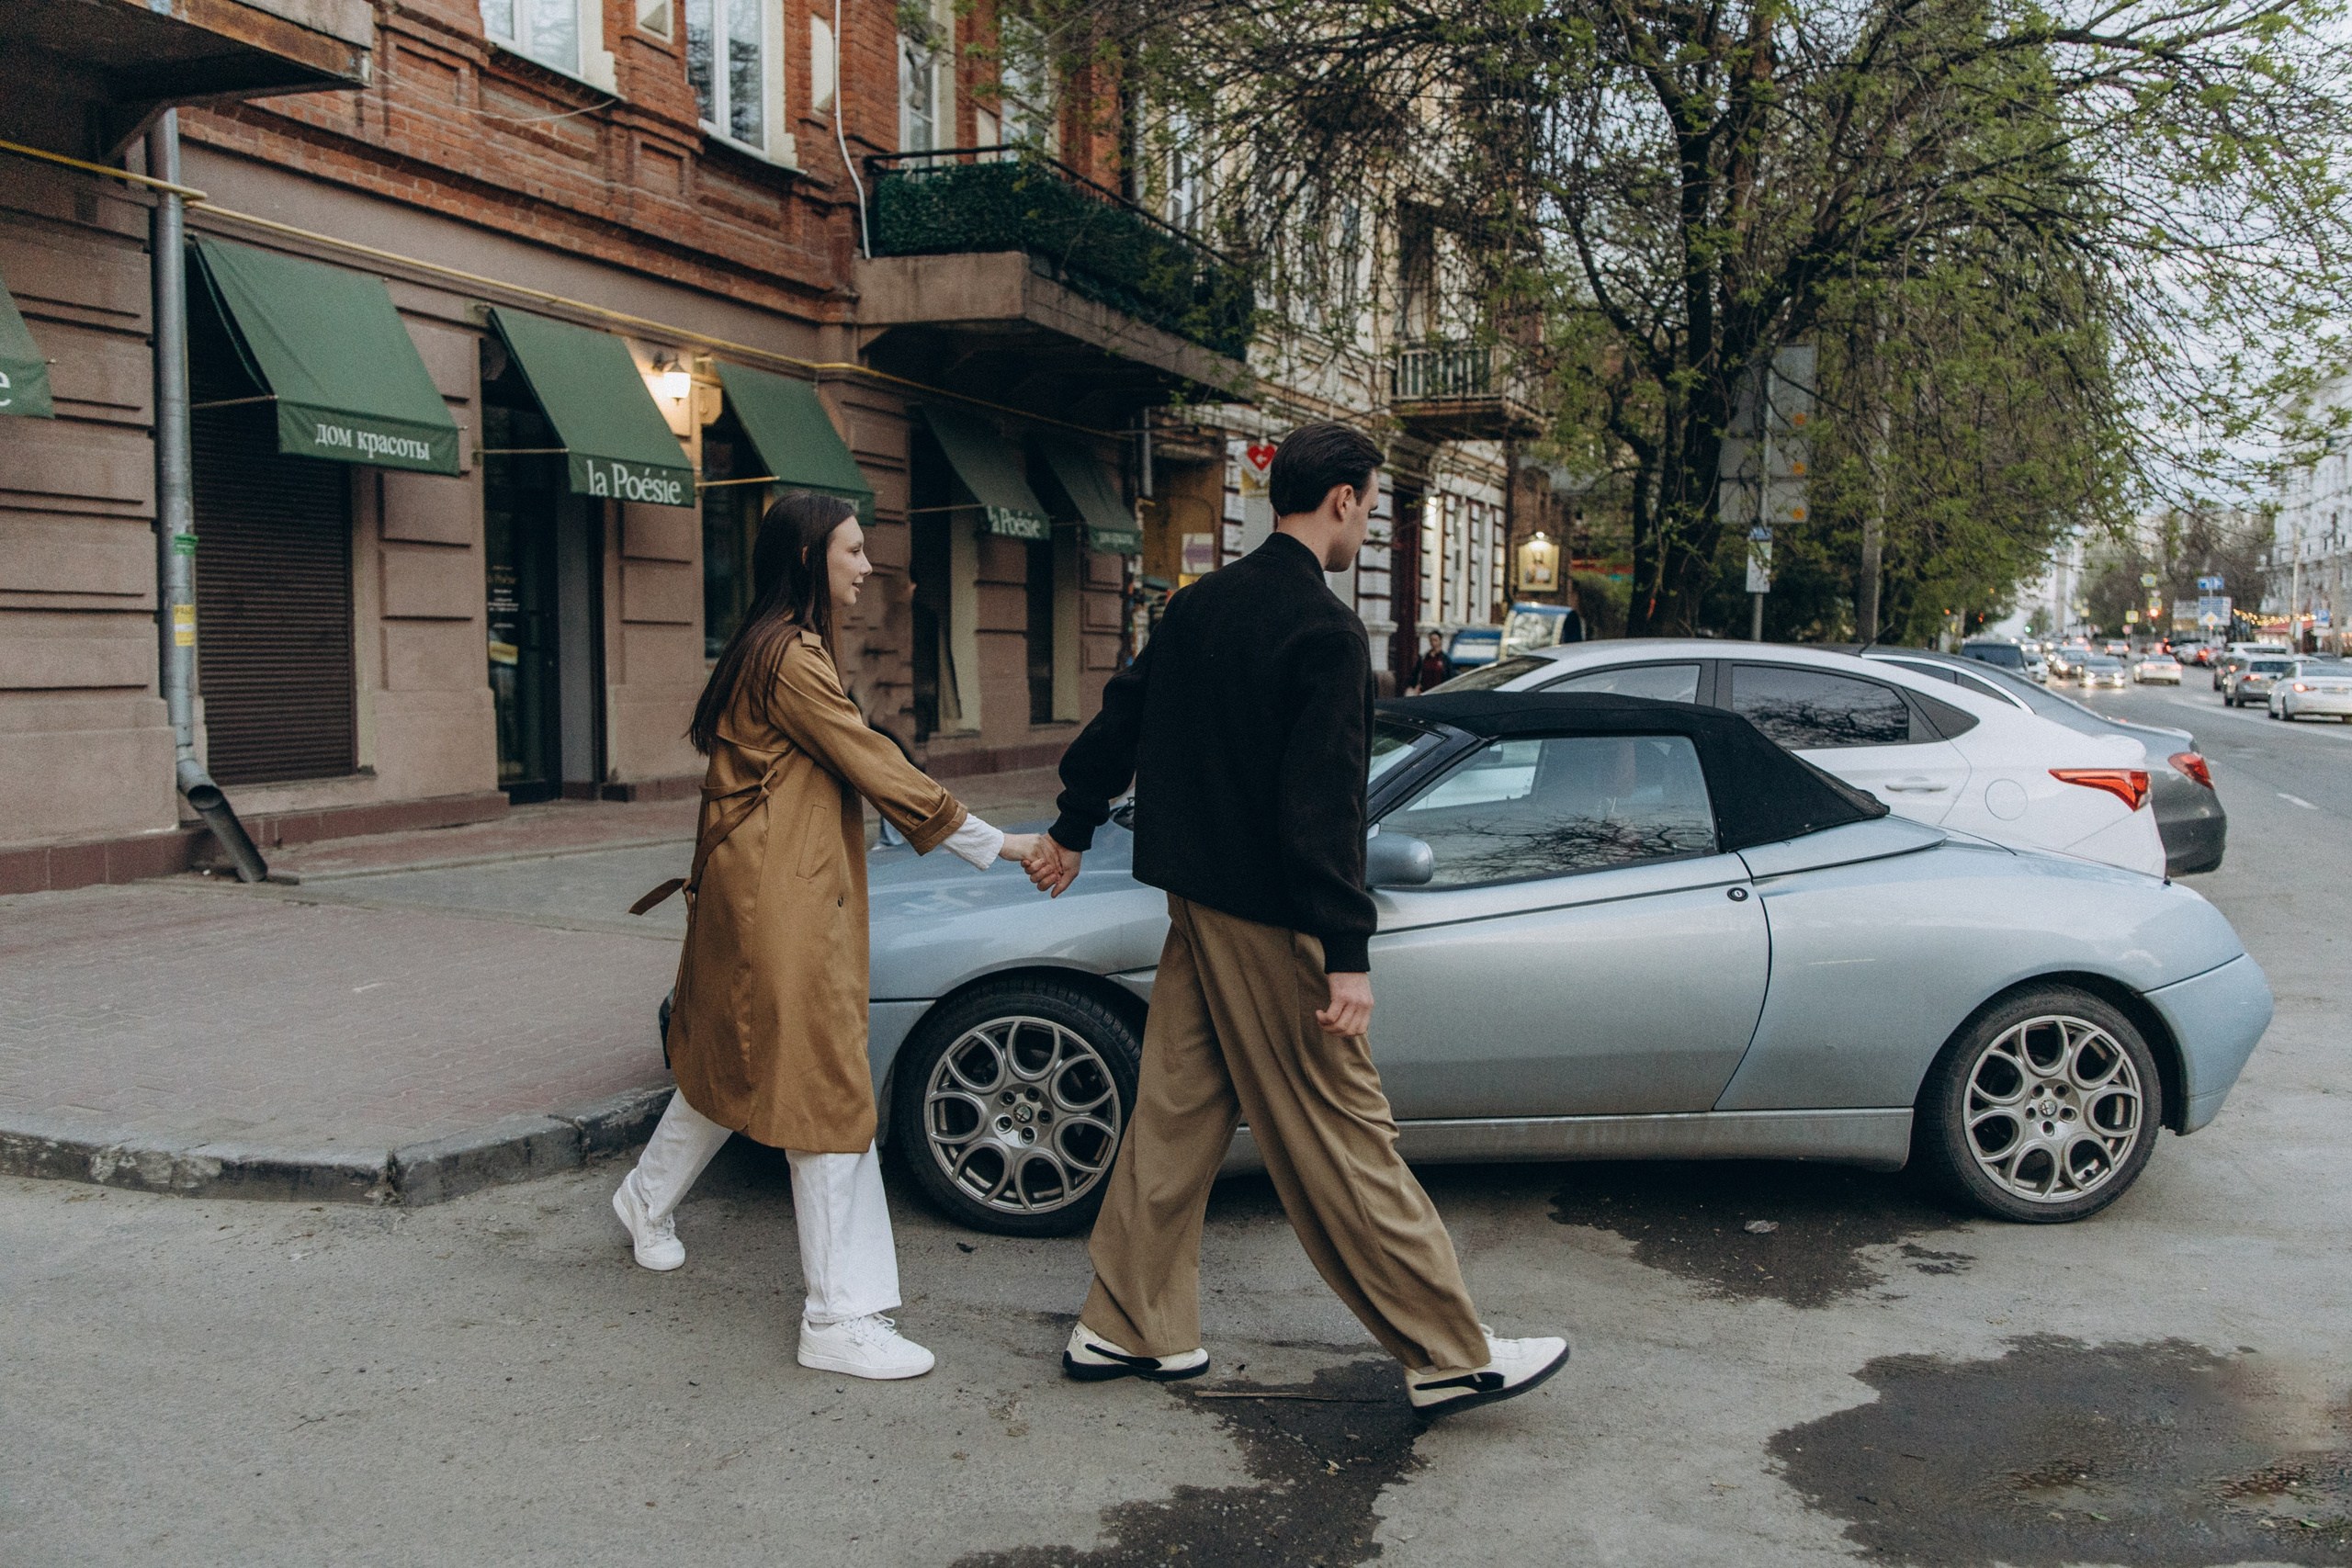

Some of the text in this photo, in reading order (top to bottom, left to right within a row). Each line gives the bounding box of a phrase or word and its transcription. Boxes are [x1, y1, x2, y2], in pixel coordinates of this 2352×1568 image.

[315, 423, 430, 461] дом красоты
[586, 459, 681, 504] la Poésie
